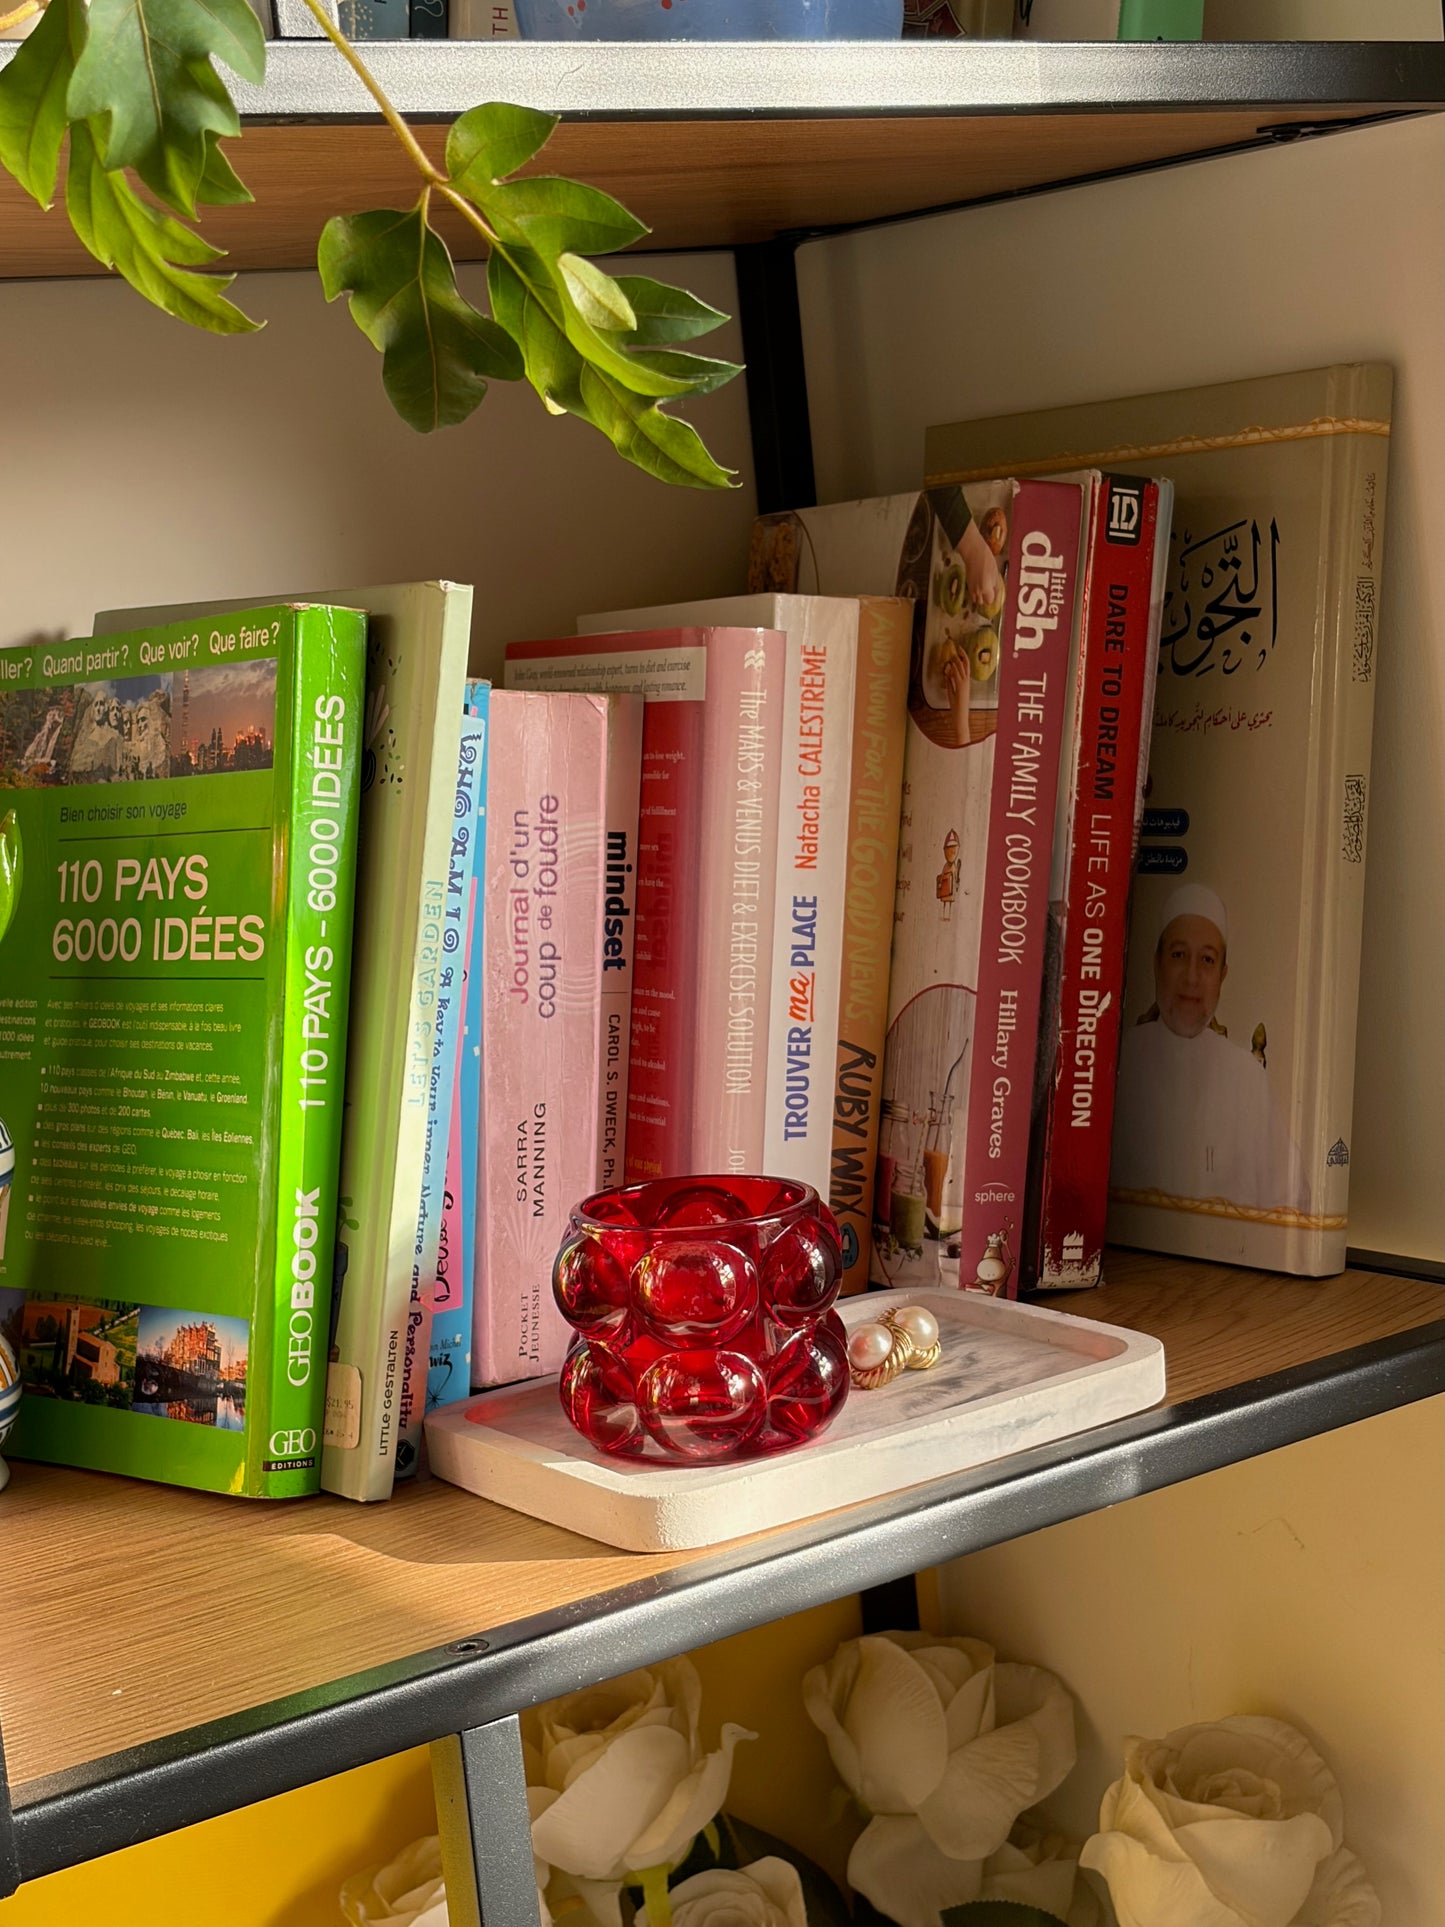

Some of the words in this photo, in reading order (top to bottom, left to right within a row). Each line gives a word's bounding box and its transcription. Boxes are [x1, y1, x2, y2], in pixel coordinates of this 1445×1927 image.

[1013, 530, 1063, 651] dish
[1048, 572, 1067, 615] little
[1104, 583, 1129, 653] DARE
[43, 651, 83, 677] Quand
[86, 644, 129, 676] partir?
[139, 641, 166, 665] Que
[168, 634, 199, 659] voir?
[209, 631, 236, 655] Que
[239, 621, 280, 651] faire?
[868, 611, 896, 667] AND
[739, 688, 768, 721] The
[867, 673, 890, 725] NOW
[1017, 672, 1048, 723] THE
[1102, 664, 1122, 696] TO
[306, 695, 345, 808] IDÉES
[737, 724, 766, 773] MARS
[862, 731, 887, 780] FOR
[1005, 731, 1043, 826] FAMILY
[1093, 706, 1120, 799] DREAM
[60, 807, 84, 823] Bien
[87, 805, 122, 818] choisir
[126, 804, 145, 816] son
[149, 802, 188, 817] voyage
[736, 780, 760, 792] &
[854, 783, 890, 832] THE
[509, 810, 530, 878] d'un
[533, 795, 559, 898] foudre
[734, 798, 763, 855] VENUS
[794, 785, 821, 870] Natacha
[1087, 815, 1112, 873] LIFE
[57, 860, 103, 903] 110
[115, 854, 209, 901] PAYS
[307, 818, 340, 912] 6000
[733, 861, 760, 901] DIET
[846, 839, 890, 931] GOOD
[537, 905, 553, 931] de
[604, 830, 633, 972] mindset
[731, 903, 758, 915] &
[790, 896, 818, 967] PLACE
[997, 833, 1033, 966] COOKBOOK
[1085, 881, 1106, 918] AS
[52, 917, 142, 962] 6000
[153, 906, 265, 961] IDÉES
[415, 880, 444, 1007] GARDEN
[509, 889, 530, 1005] Journal
[728, 921, 759, 1002] EXERCISE
[1079, 928, 1103, 980] ONE
[302, 946, 334, 1038] PAYS
[537, 943, 562, 1019] coup
[787, 971, 812, 1023] ma
[607, 1013, 621, 1067] CAROL
[726, 1007, 756, 1094] SOLUTION
[990, 990, 1018, 1068] Hillary
[1070, 990, 1100, 1127] DIRECTION
[298, 1050, 329, 1110] 110
[606, 1070, 619, 1087] S.
[783, 1026, 812, 1142] TROUVER
[833, 1039, 878, 1138] RUBY
[602, 1091, 618, 1154] DWECK,
[987, 1077, 1010, 1159] Graves
[516, 1119, 528, 1203] SARRA
[533, 1101, 547, 1218] MANNING
[829, 1146, 868, 1218] WAX
[974, 1189, 1016, 1205] sphere
[287, 1187, 321, 1386] GEOBOOK
[517, 1292, 529, 1358] POCKET
[528, 1284, 541, 1362] JEUNESSE
[382, 1330, 400, 1410] GESTALTEN
[268, 1428, 316, 1457] GEO
[379, 1414, 393, 1456] LITTLE
